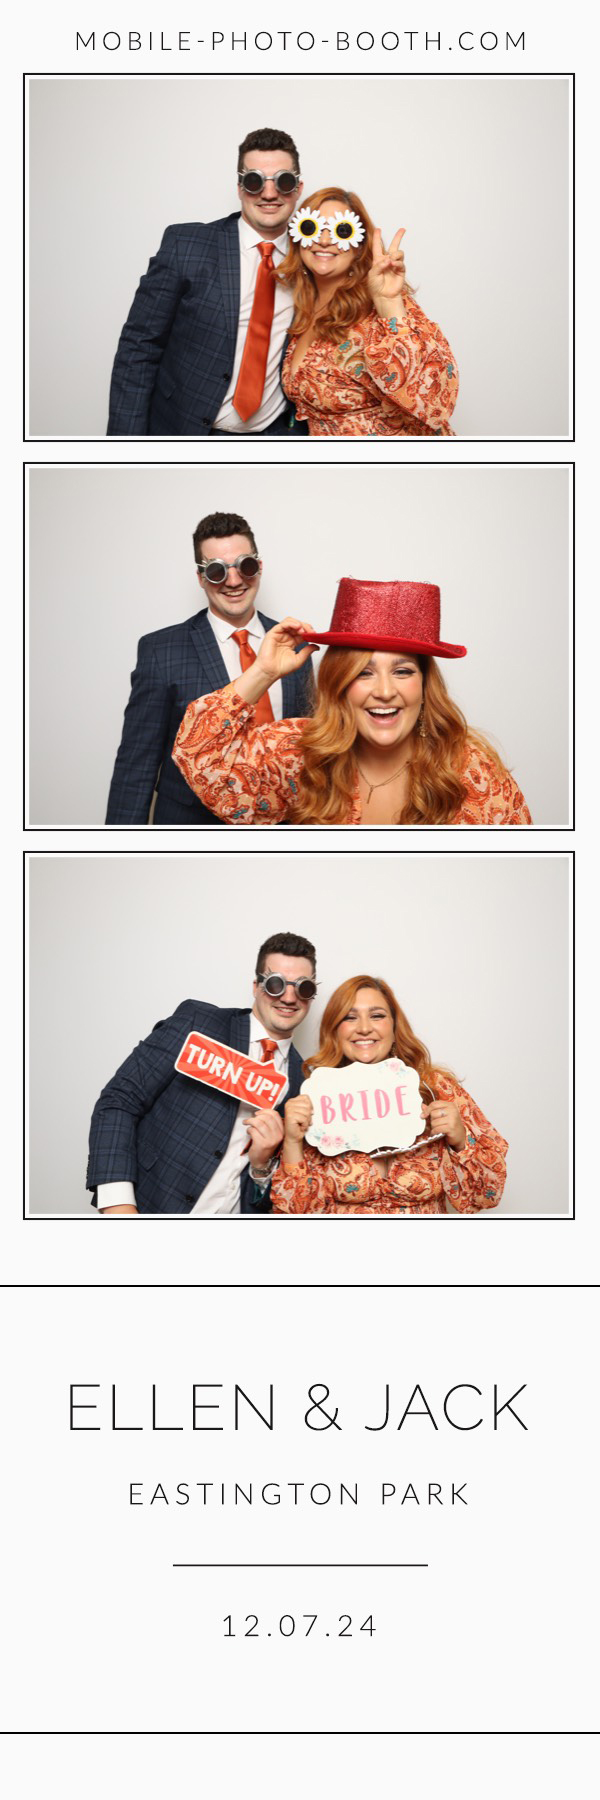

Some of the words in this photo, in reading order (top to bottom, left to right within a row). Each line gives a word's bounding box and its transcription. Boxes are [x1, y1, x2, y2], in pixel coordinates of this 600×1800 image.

[186, 1043, 244, 1085] TURN
[244, 1074, 280, 1102] UP!
[319, 1085, 411, 1125] BRIDE
